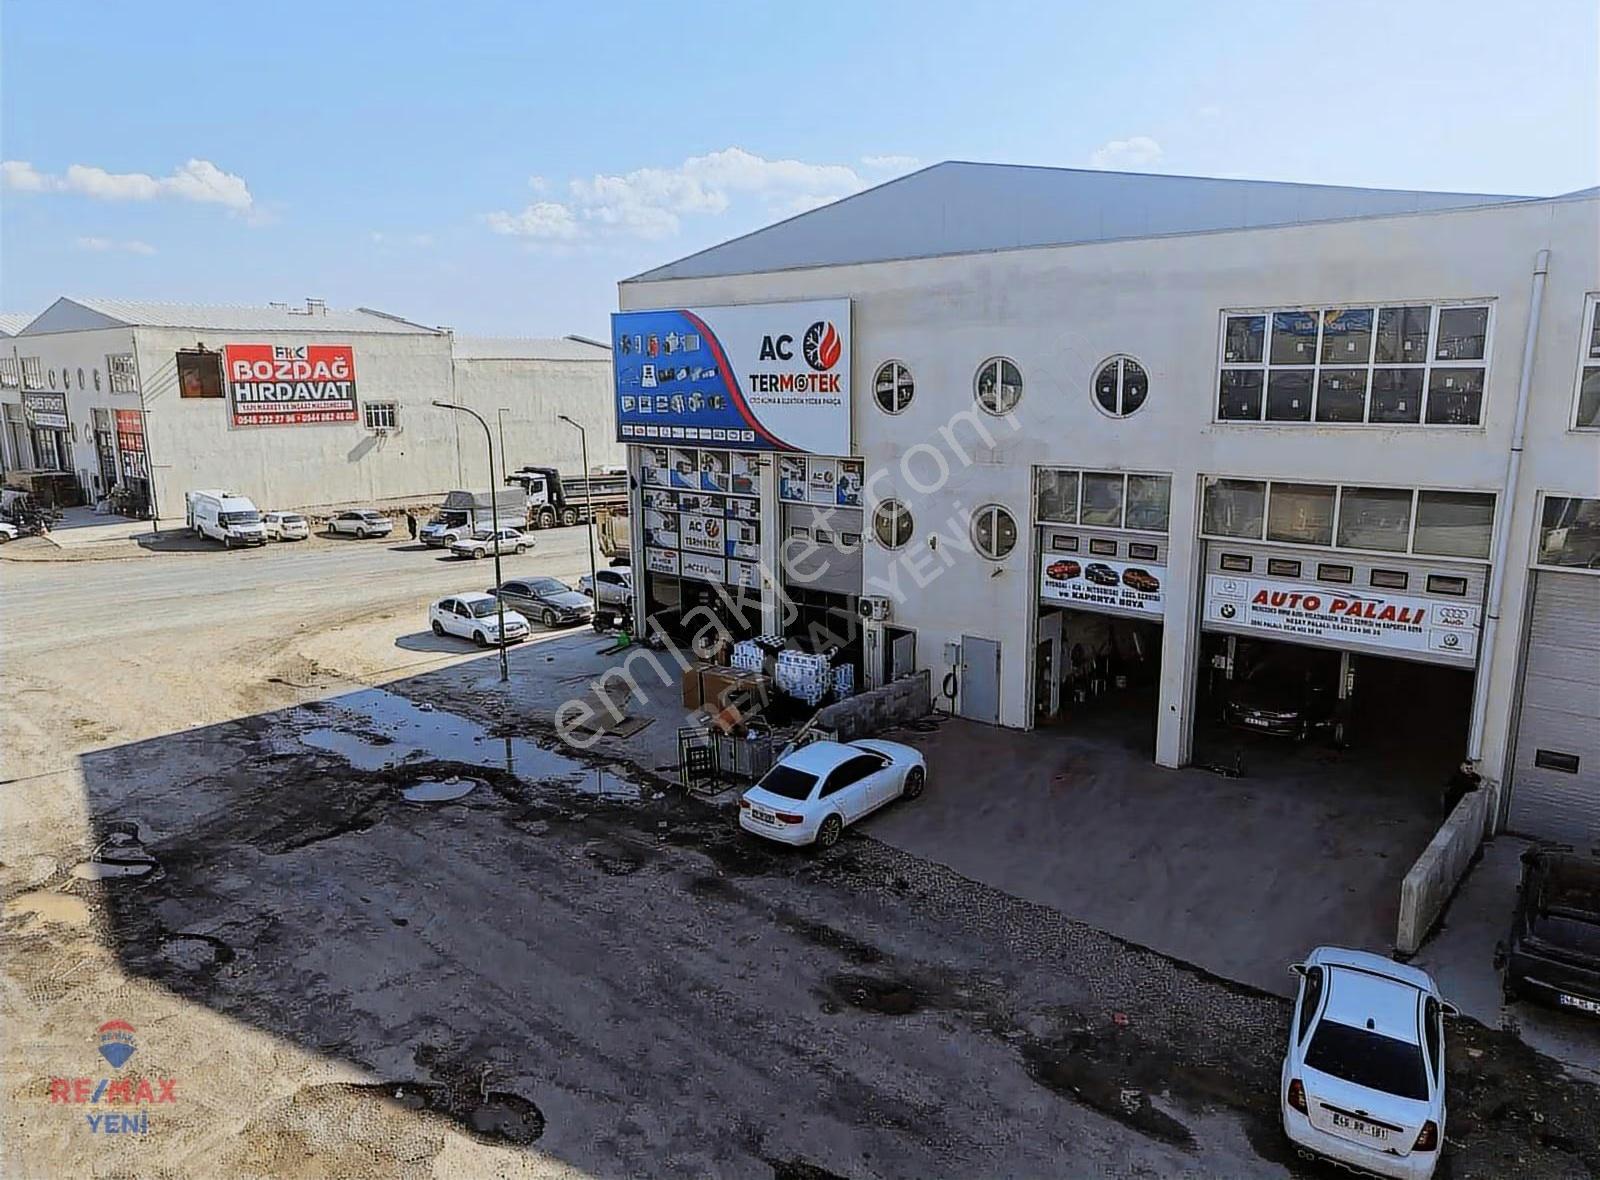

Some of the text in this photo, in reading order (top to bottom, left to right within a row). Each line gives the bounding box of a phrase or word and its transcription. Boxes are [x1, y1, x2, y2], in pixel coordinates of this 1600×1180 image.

[760, 334, 793, 360] AC
[233, 356, 349, 380] BOZDAĞ
[235, 381, 351, 401] HIRDAVAT
[749, 373, 841, 392] TERMOTEK
[689, 520, 703, 532] AC
[1252, 590, 1426, 624] AUTO PALALI
